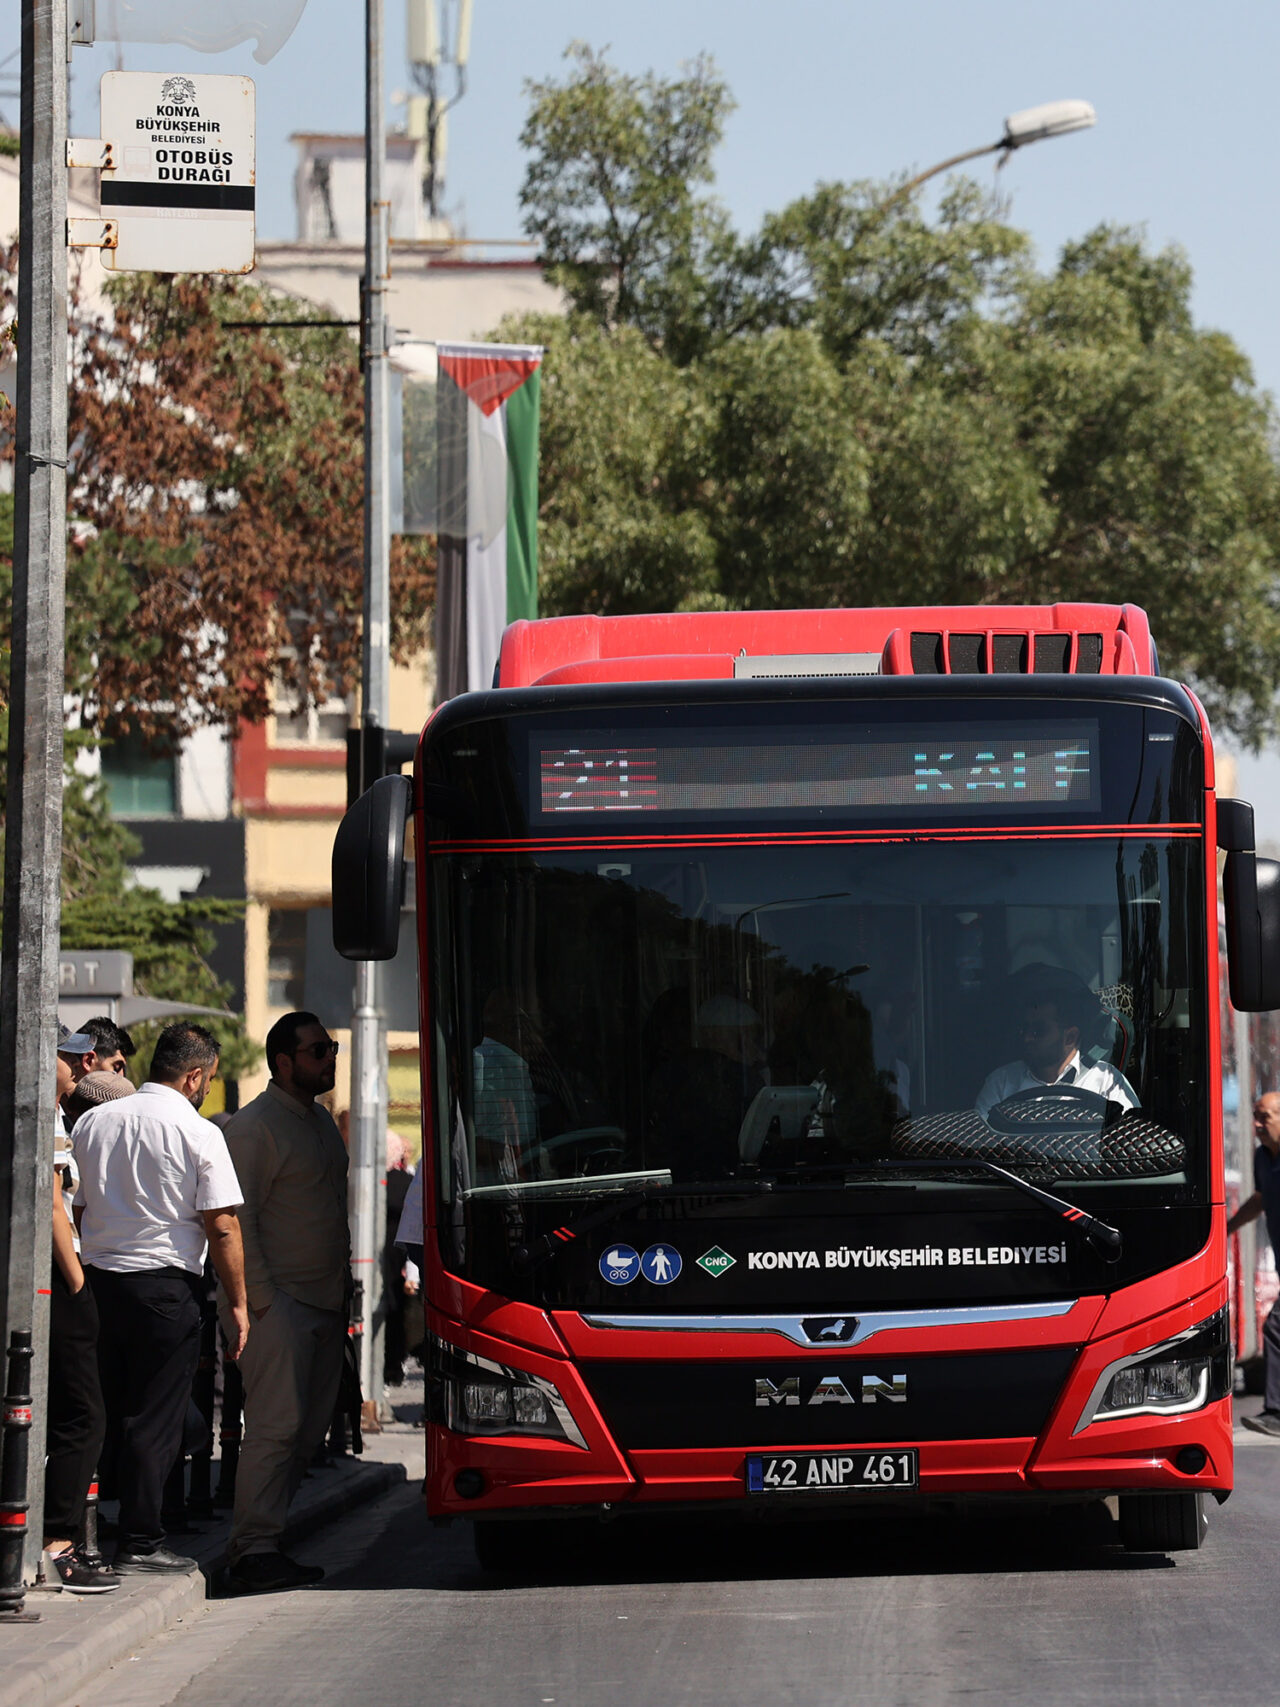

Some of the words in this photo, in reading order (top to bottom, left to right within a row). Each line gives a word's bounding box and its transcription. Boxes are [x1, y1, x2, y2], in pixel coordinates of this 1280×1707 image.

[156, 105, 200, 117] KONYA
[135, 116, 220, 134] BÜYÜKŞEHİR
[151, 134, 206, 144] BELEDİYESİ
[155, 148, 233, 165] OTOBÜS
[158, 165, 231, 182] DURAĞI
[704, 1256, 728, 1267] CNG
[748, 1251, 820, 1269] KONYA
[825, 1244, 944, 1270] BÜYÜKŞEHİR
[755, 1373, 907, 1407] MAN
[764, 1459, 797, 1486] 42
[806, 1457, 854, 1485] ANP
[863, 1455, 909, 1483] 461
